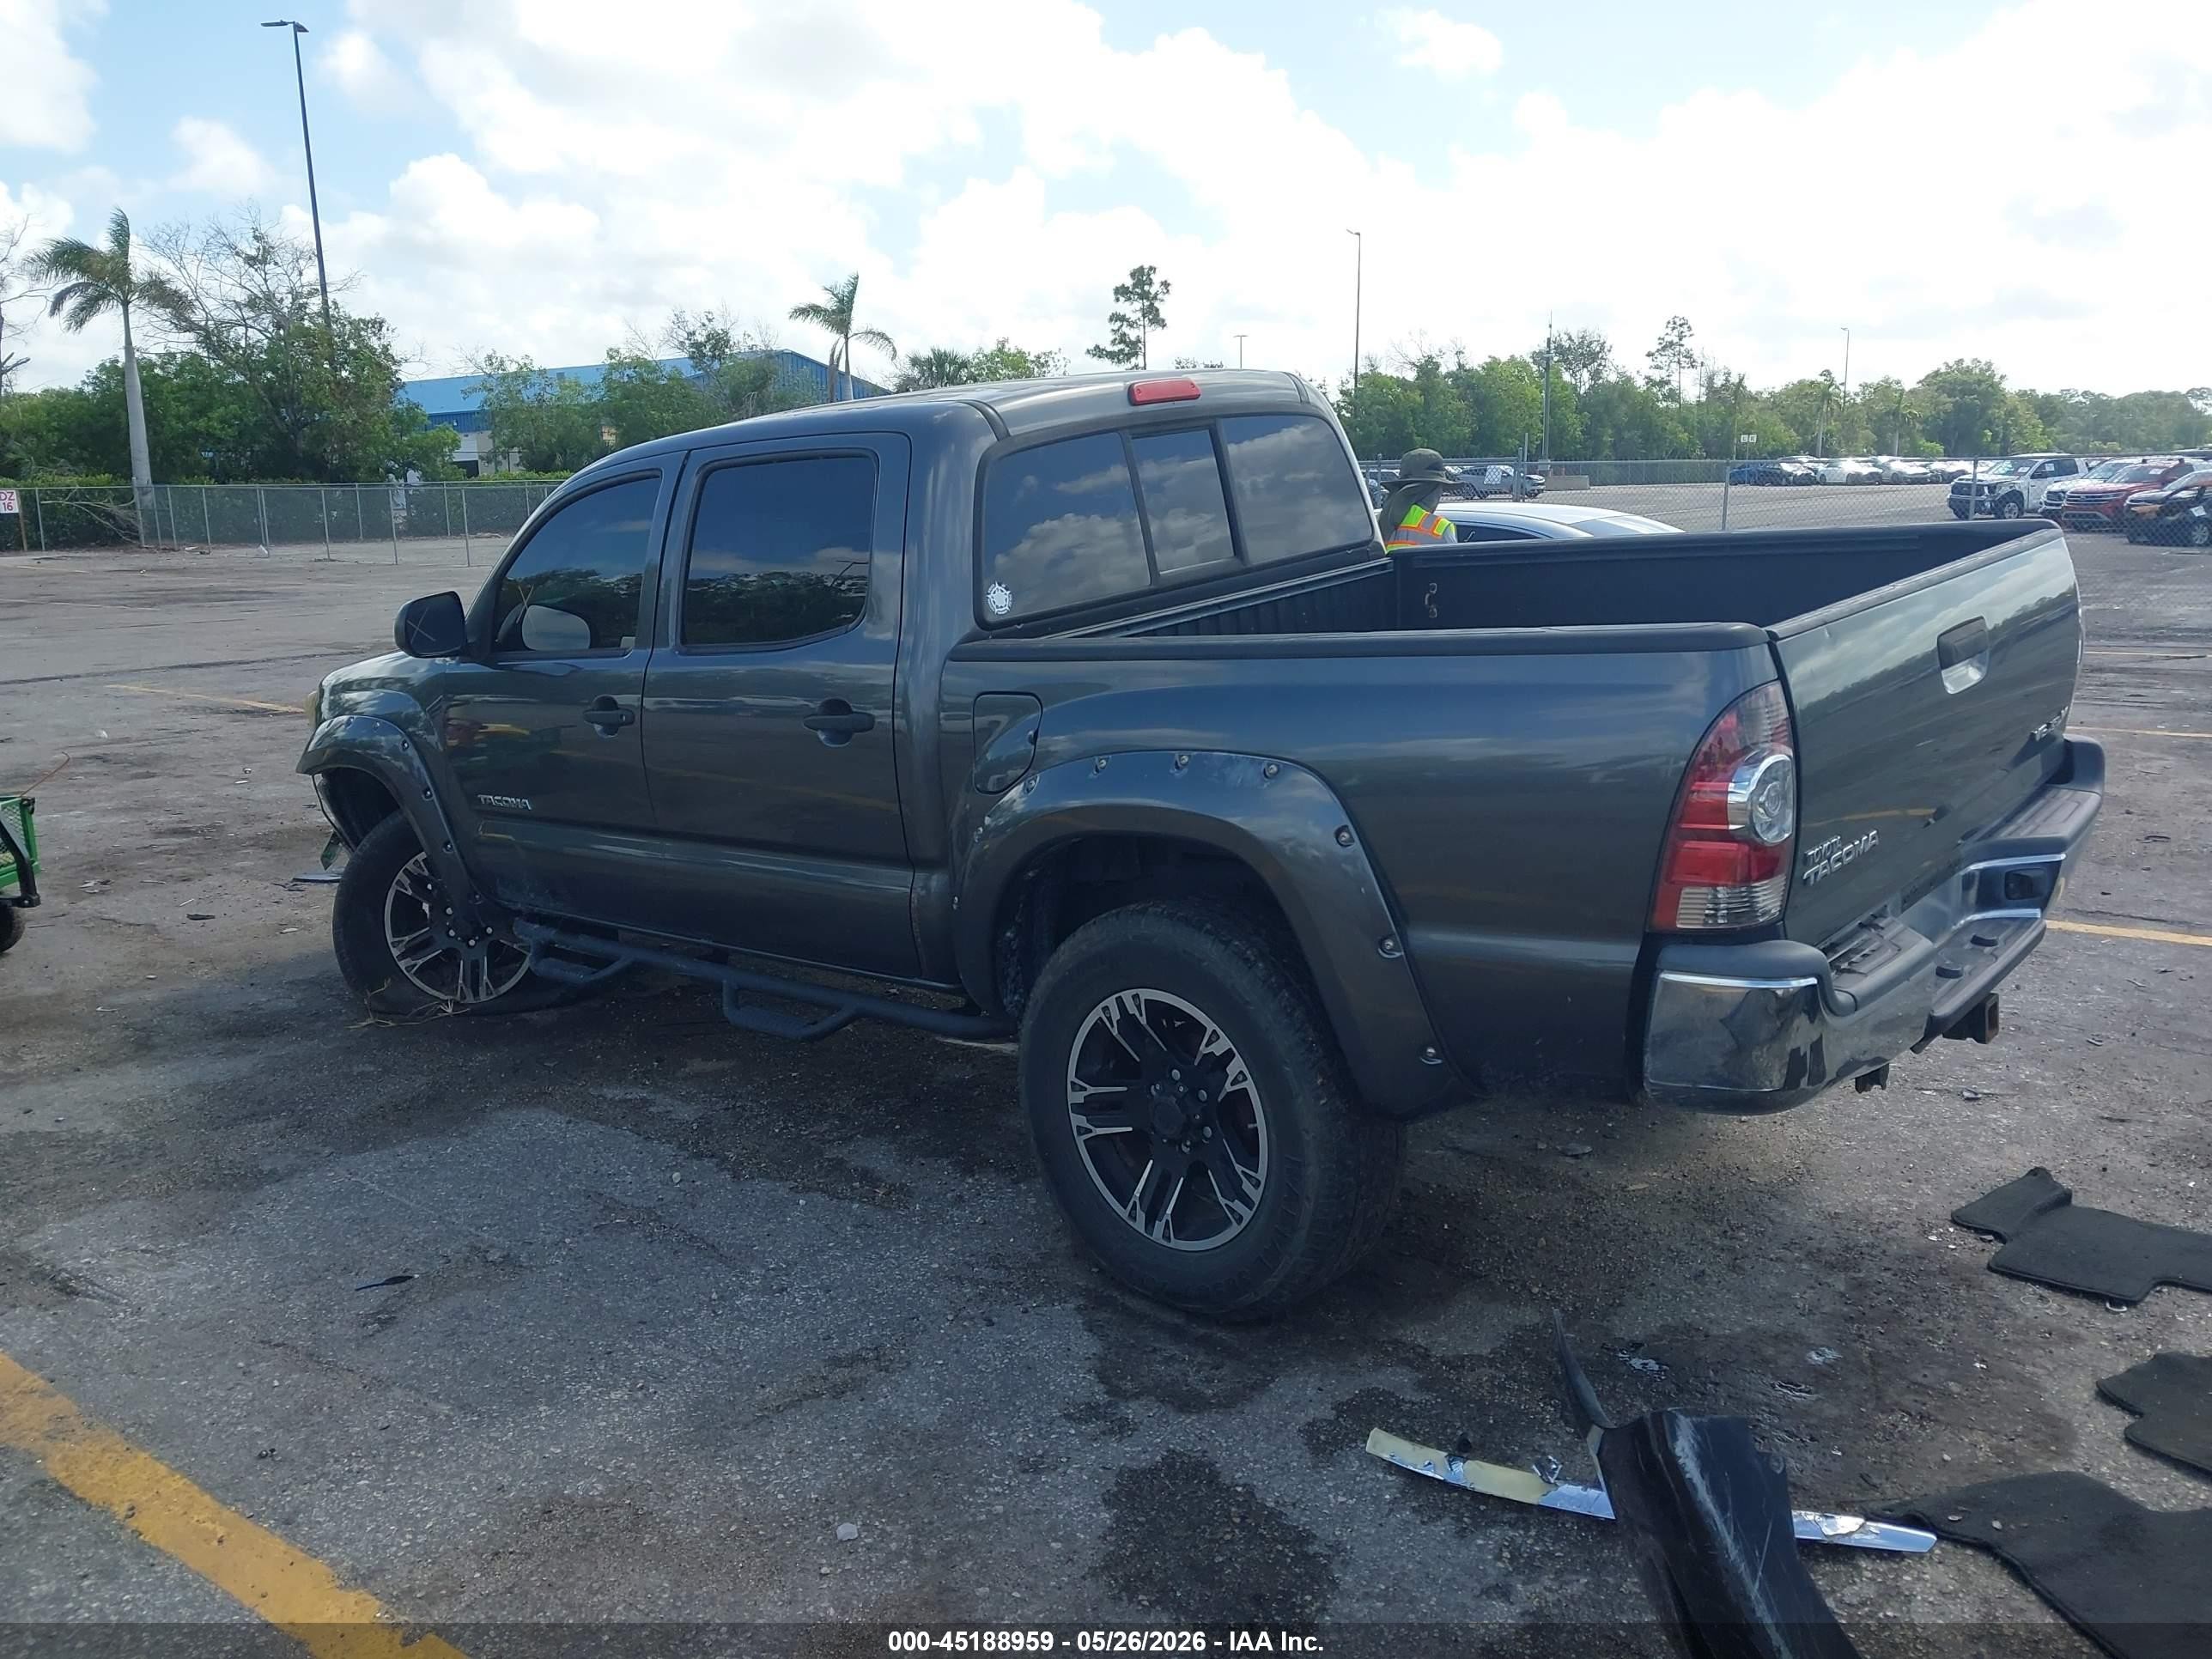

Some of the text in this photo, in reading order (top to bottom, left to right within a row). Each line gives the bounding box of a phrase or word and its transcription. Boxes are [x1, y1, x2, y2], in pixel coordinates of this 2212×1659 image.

[0, 491, 15, 501] DZ
[3, 501, 14, 512] 16
[477, 794, 532, 811] TACOMA
[1802, 830, 1880, 886] TACOMA
